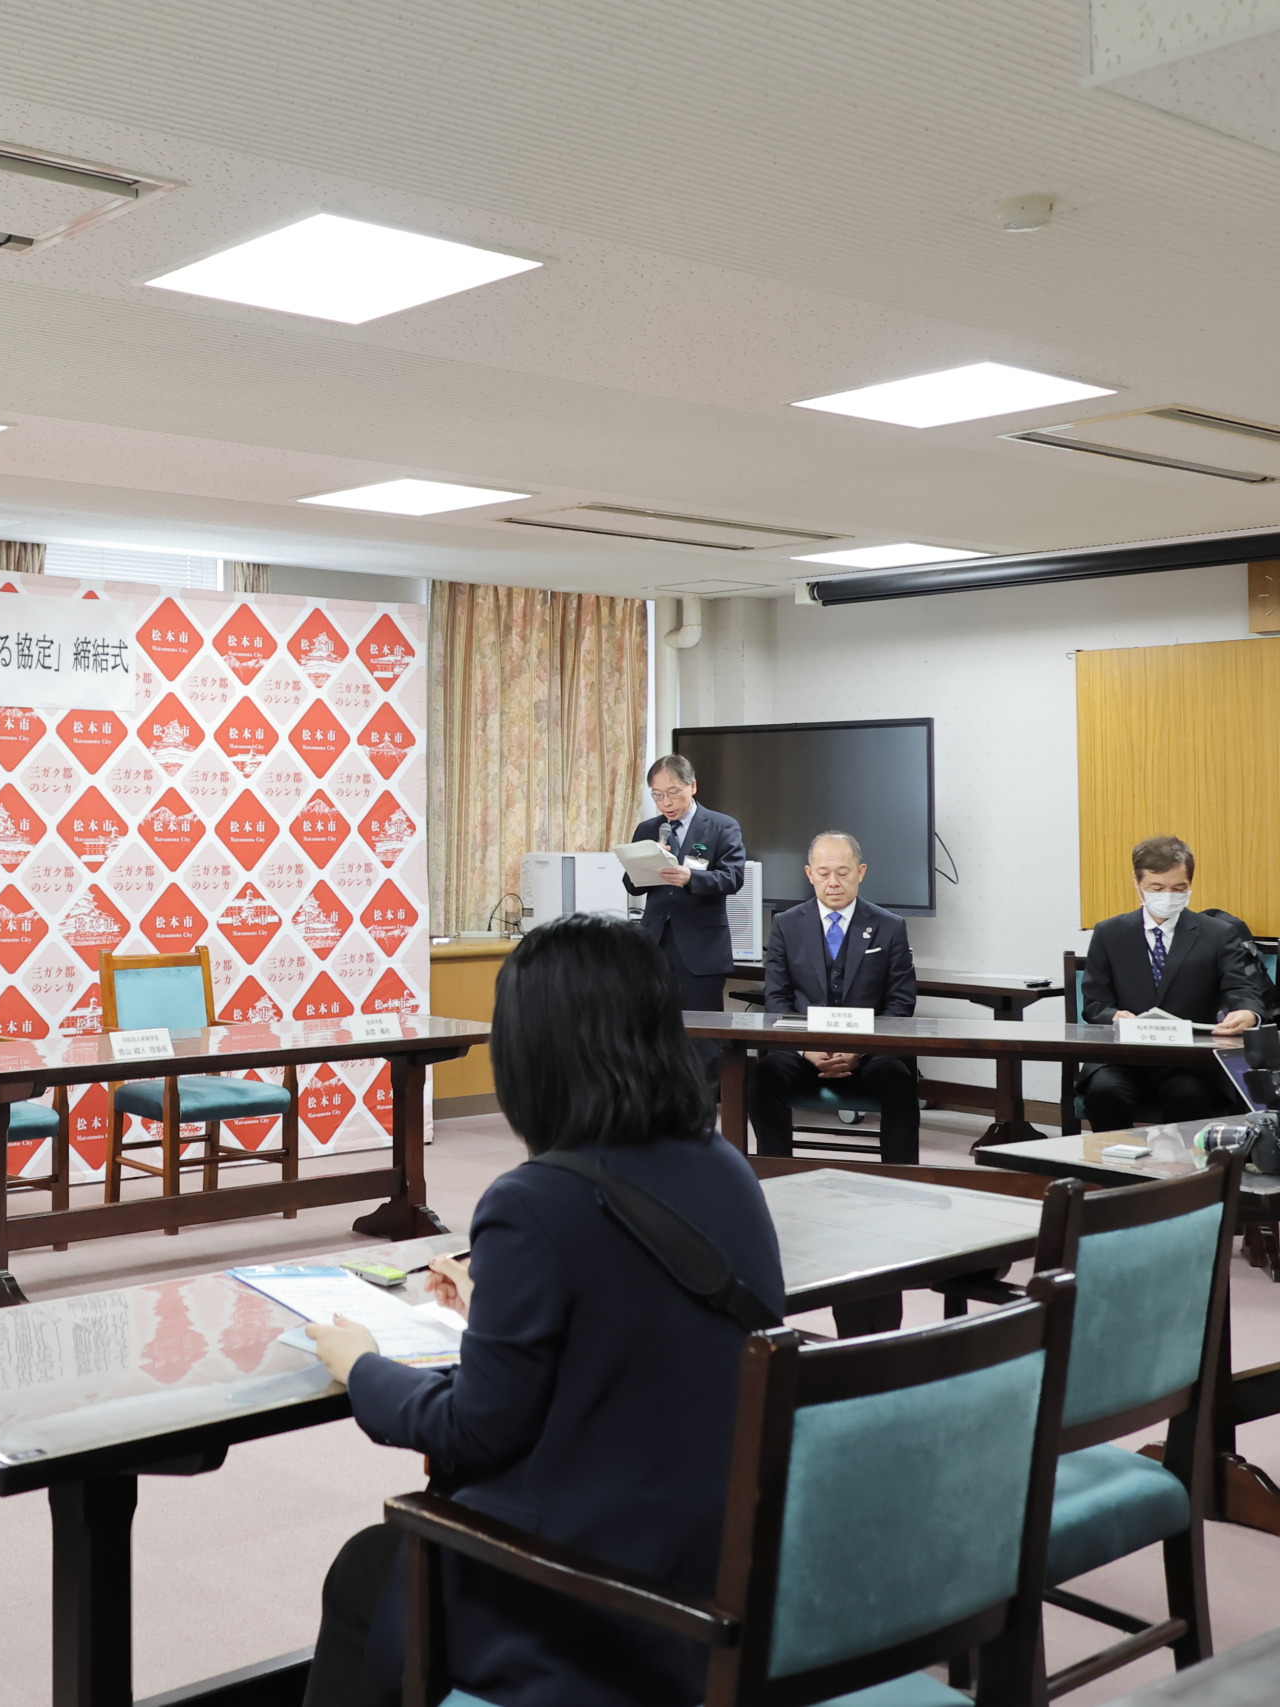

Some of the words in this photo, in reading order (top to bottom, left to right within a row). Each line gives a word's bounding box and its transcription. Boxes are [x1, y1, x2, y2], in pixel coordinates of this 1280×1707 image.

[151, 629, 188, 644] 松本市
[228, 634, 263, 648] 松本市
[370, 643, 404, 656] 松本市
[189, 676, 228, 689] 三ガク都
[263, 679, 301, 692] 三ガク都
[335, 683, 371, 695] 三ガク都
[73, 721, 112, 734] 松本市
[228, 727, 264, 740] 松本市
[18, 734, 30, 743] City
[302, 728, 336, 741] 松本市
[371, 731, 403, 743] 松本市
[73, 737, 101, 745] Matsumoto
[102, 738, 112, 746] City
[29, 766, 73, 779] 三ガク都
[112, 768, 153, 781] 三ガク都
[190, 769, 229, 783] 三ガク都
[265, 771, 302, 783] 三ガク都
[336, 773, 371, 785] 三ガク都
[73, 819, 112, 832] 松本市
[153, 820, 190, 833] 松本市
[230, 821, 265, 833] 松本市
[303, 820, 336, 832] 松本市
[30, 865, 74, 878] 三ガク都
[113, 864, 155, 877] 三ガク都
[191, 864, 231, 877] 三ガク都
[266, 863, 304, 876] 三ガク都
[336, 862, 373, 874] 三ガク都
[232, 914, 268, 927] 松本市
[373, 908, 406, 921] 松本市
[155, 915, 193, 929] 松本市
[20, 936, 32, 945] City
[183, 931, 193, 939] City
[268, 956, 306, 969] 三ガク都
[338, 952, 375, 965] 三ガク都
[31, 965, 76, 979] 三ガク都
[306, 1001, 340, 1016] 松本市
[76, 1017, 100, 1031] 松本
[307, 1093, 341, 1109] 松本市
[332, 1109, 341, 1118] City
[76, 1116, 108, 1131] 松本
[21, 1139, 33, 1148] City
[76, 1133, 104, 1142] Matsumoto
